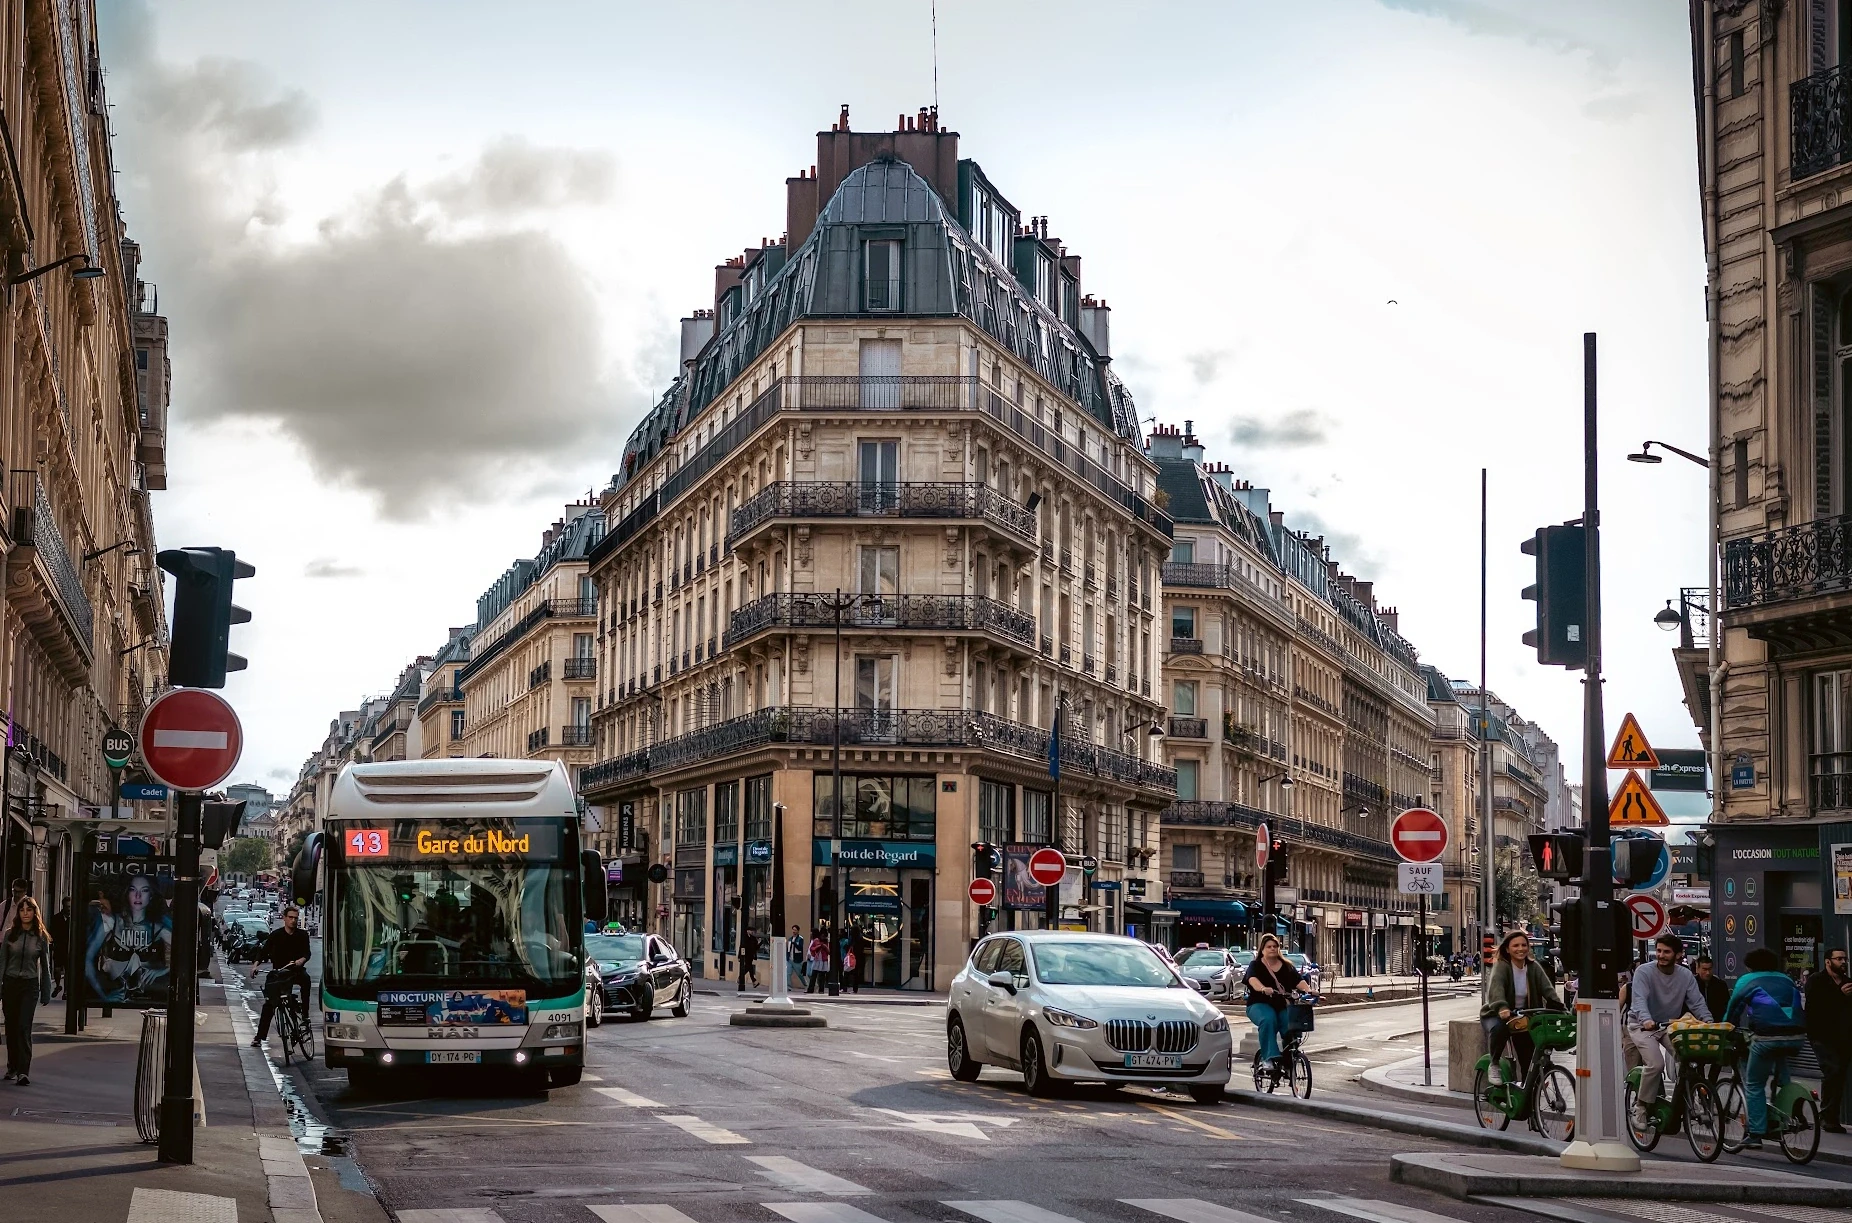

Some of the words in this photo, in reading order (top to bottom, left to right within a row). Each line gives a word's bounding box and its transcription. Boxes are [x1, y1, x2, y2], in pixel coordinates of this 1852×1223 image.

[106, 738, 130, 751] BUS
[141, 788, 163, 797] Cadet
[622, 804, 632, 816] R
[351, 832, 383, 853] 43
[417, 830, 460, 854] Gare
[463, 834, 484, 853] du
[487, 829, 530, 854] Nord
[832, 848, 858, 859] roit
[860, 848, 874, 859] de
[875, 849, 918, 864] Regard
[1732, 849, 1772, 859] L'OCCASION
[1772, 849, 1791, 858] TOUT
[1409, 867, 1433, 875] SAUF
[120, 929, 151, 947] ANGEL
[390, 993, 450, 1003] NOCTURNE
[548, 1013, 572, 1022] 4091
[427, 1027, 479, 1038] MAN
